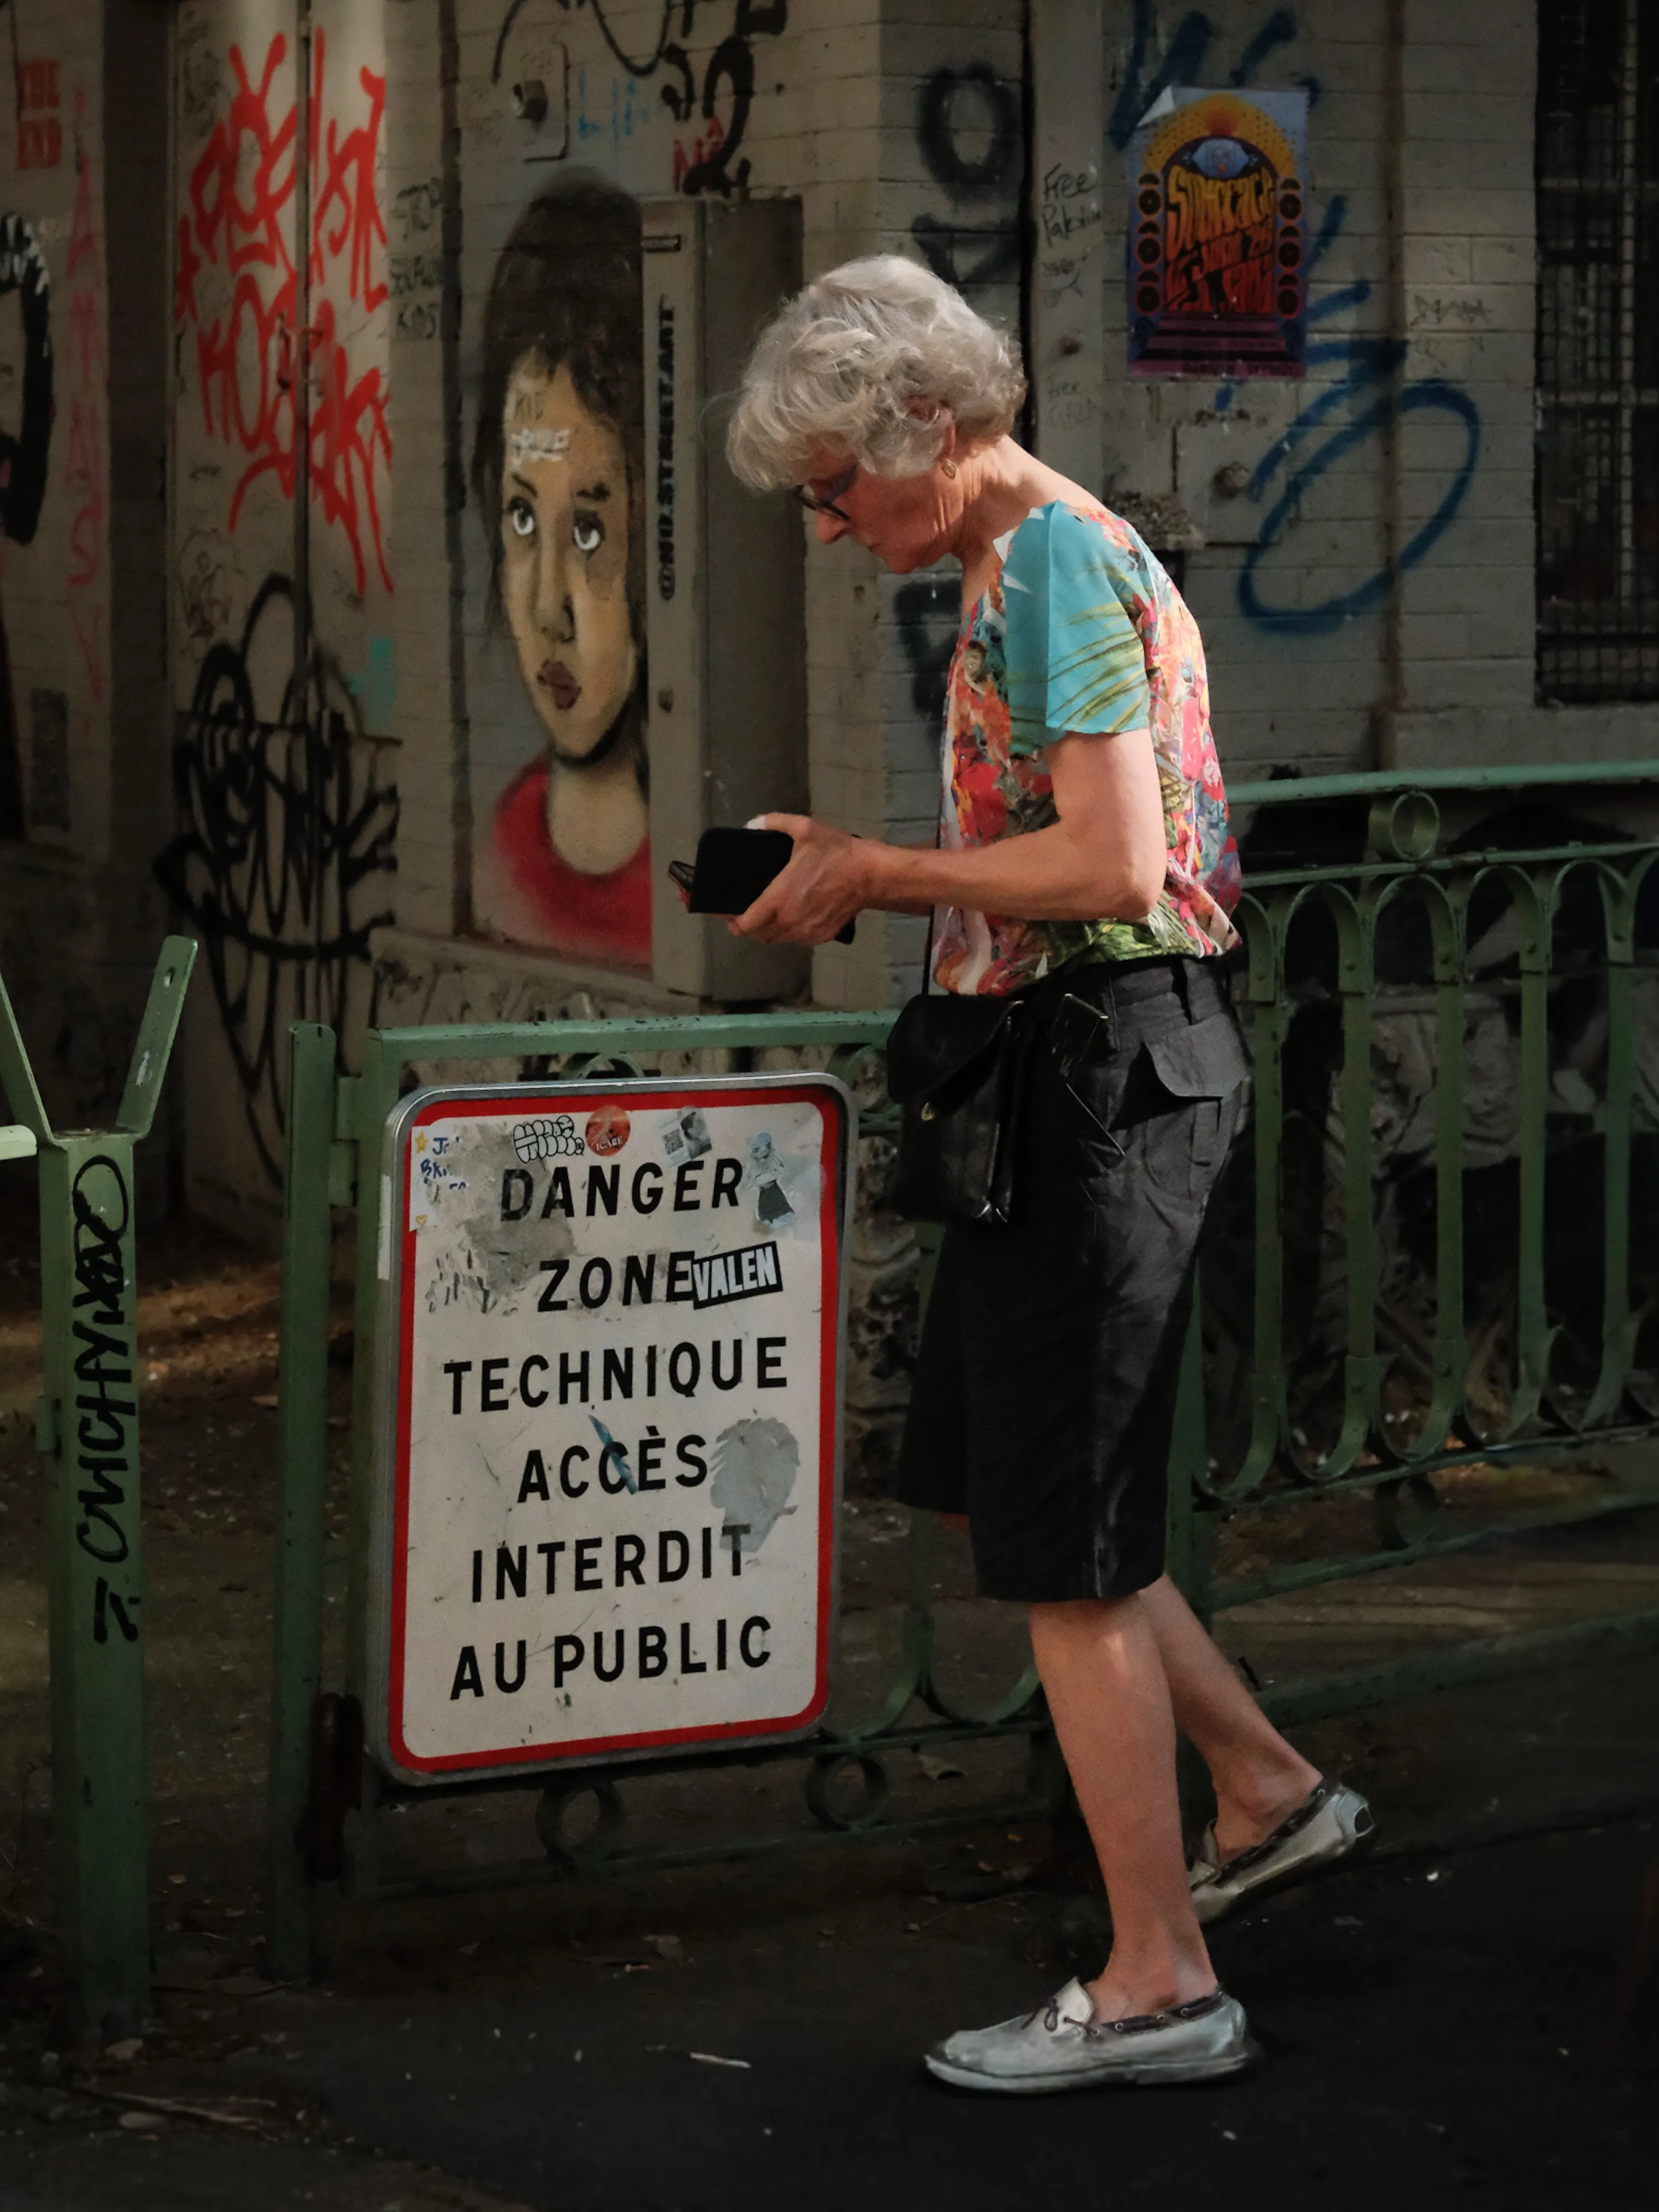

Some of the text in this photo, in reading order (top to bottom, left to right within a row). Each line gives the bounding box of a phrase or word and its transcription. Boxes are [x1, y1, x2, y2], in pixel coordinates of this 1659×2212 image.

[500, 1157, 743, 1222] DANGER
[537, 1250, 695, 1312] ZONE
[693, 1245, 778, 1301] VALEN
[443, 1337, 787, 1415] TECHNIQUE
[517, 1425, 708, 1503] ACCÈS
[472, 1524, 751, 1603] INTERDIT
[450, 1616, 771, 1701] AU PUBLIC
